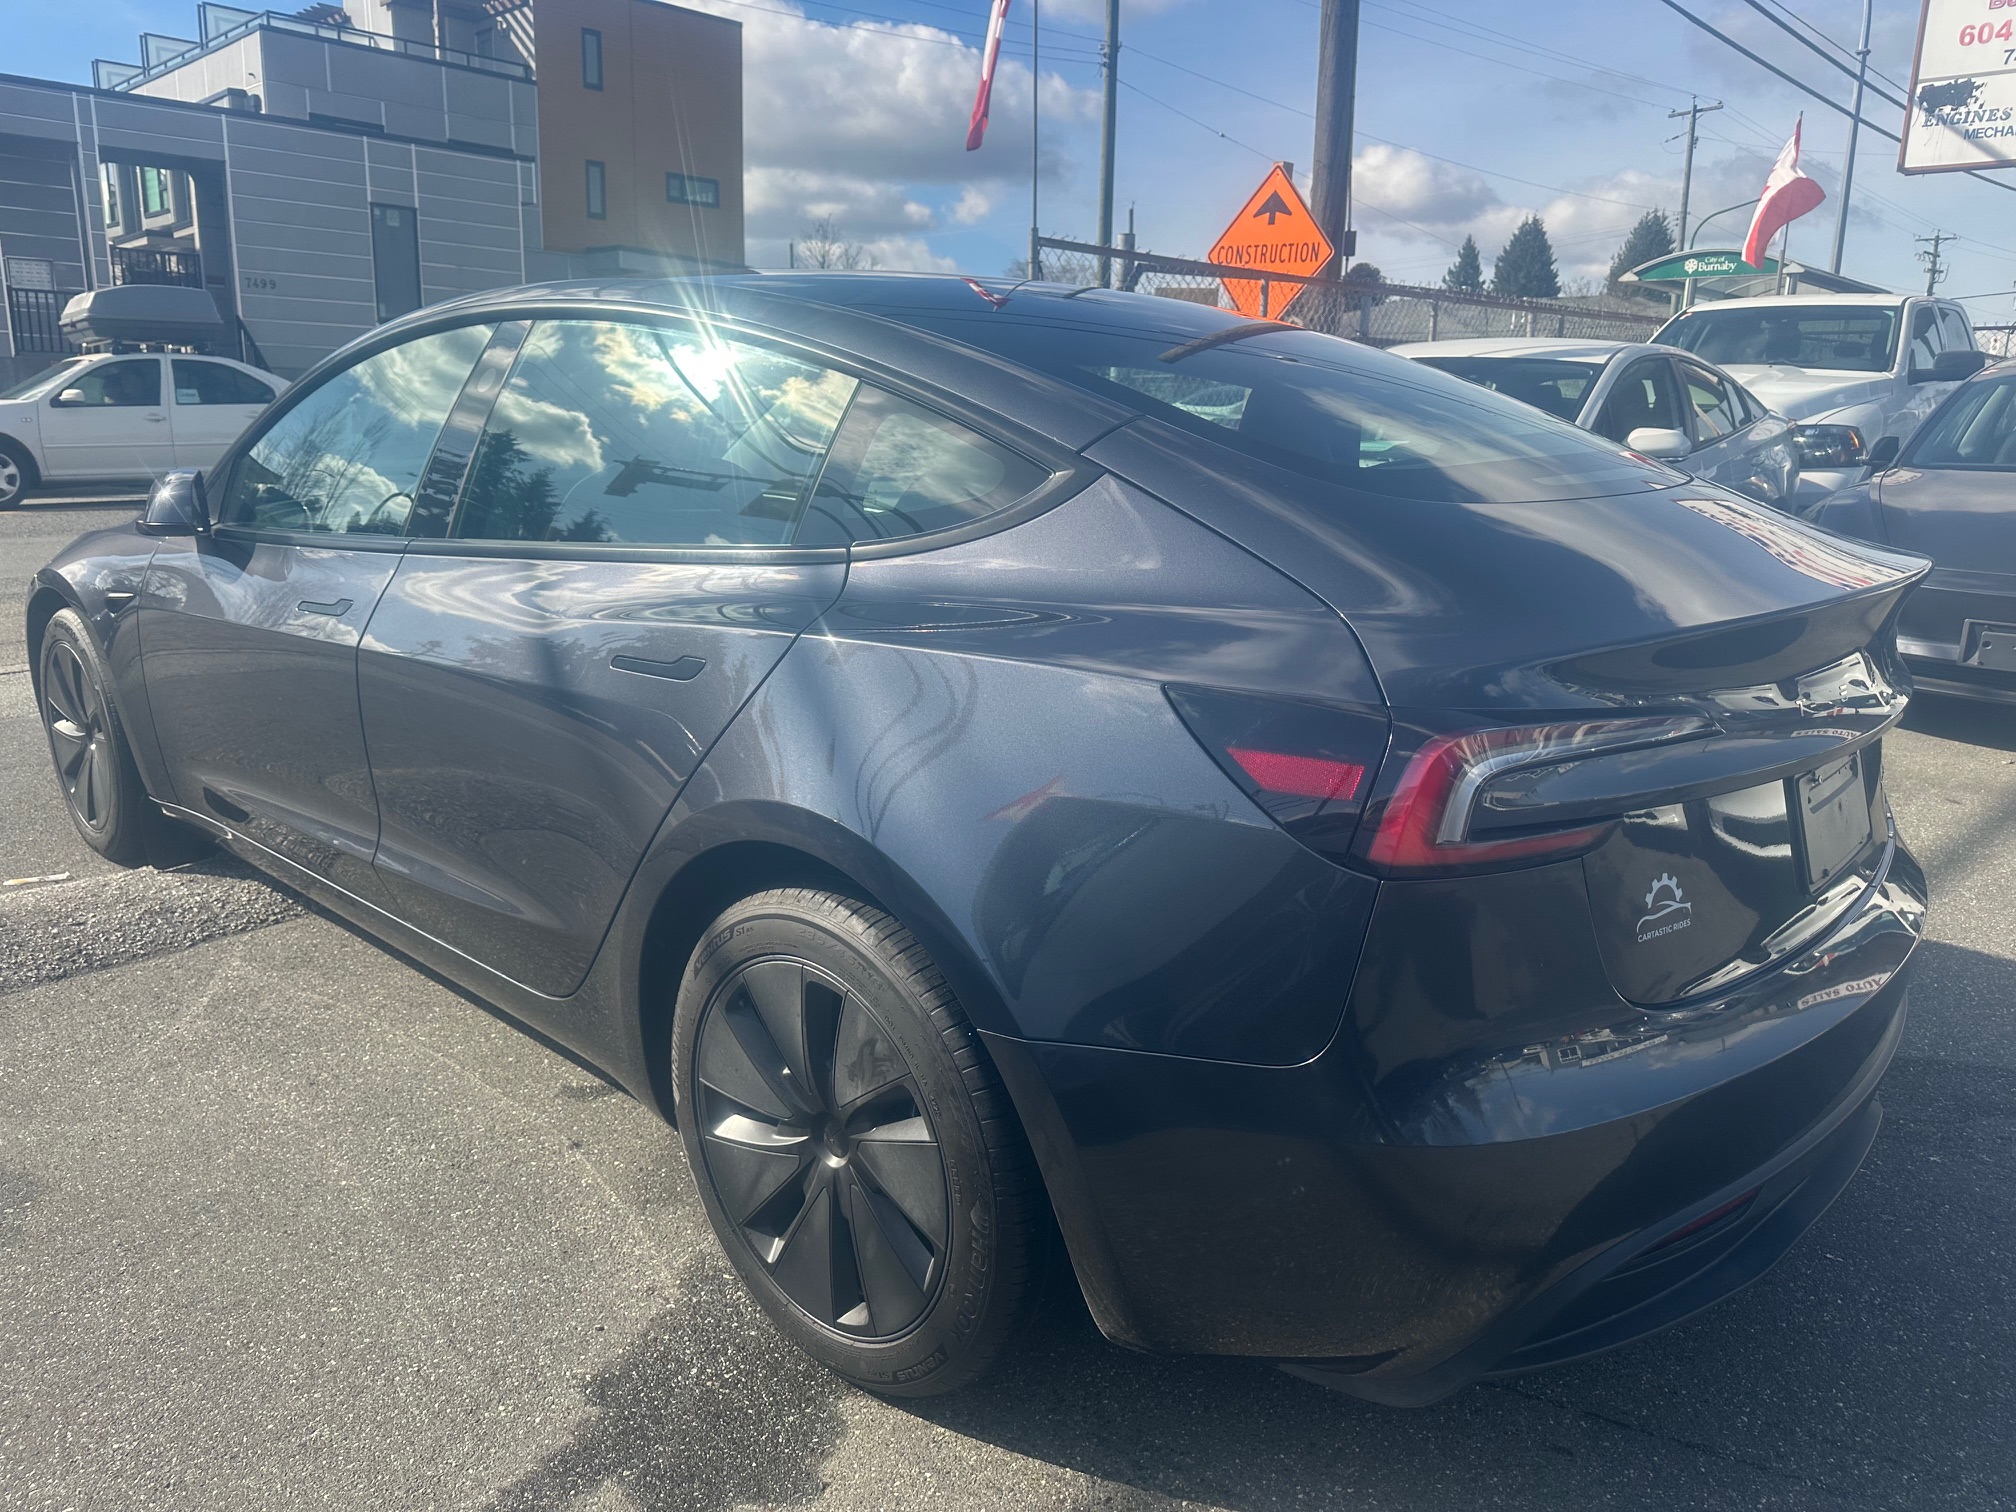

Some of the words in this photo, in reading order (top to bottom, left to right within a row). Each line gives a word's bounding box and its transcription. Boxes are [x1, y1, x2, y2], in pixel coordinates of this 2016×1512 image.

[1959, 19, 2013, 47] 604
[1921, 107, 2013, 128] ENGINES
[1963, 125, 2016, 140] MECHA
[1217, 242, 1320, 265] CONSTRUCTION
[1704, 256, 1718, 264] City
[1698, 261, 1737, 273] Burnaby
[244, 277, 276, 290] 7499
[1637, 924, 1673, 943] CARTASTIC
[1673, 918, 1692, 932] RIDES
[1845, 976, 1883, 993] AUTO
[1800, 988, 1841, 1007] SALES
